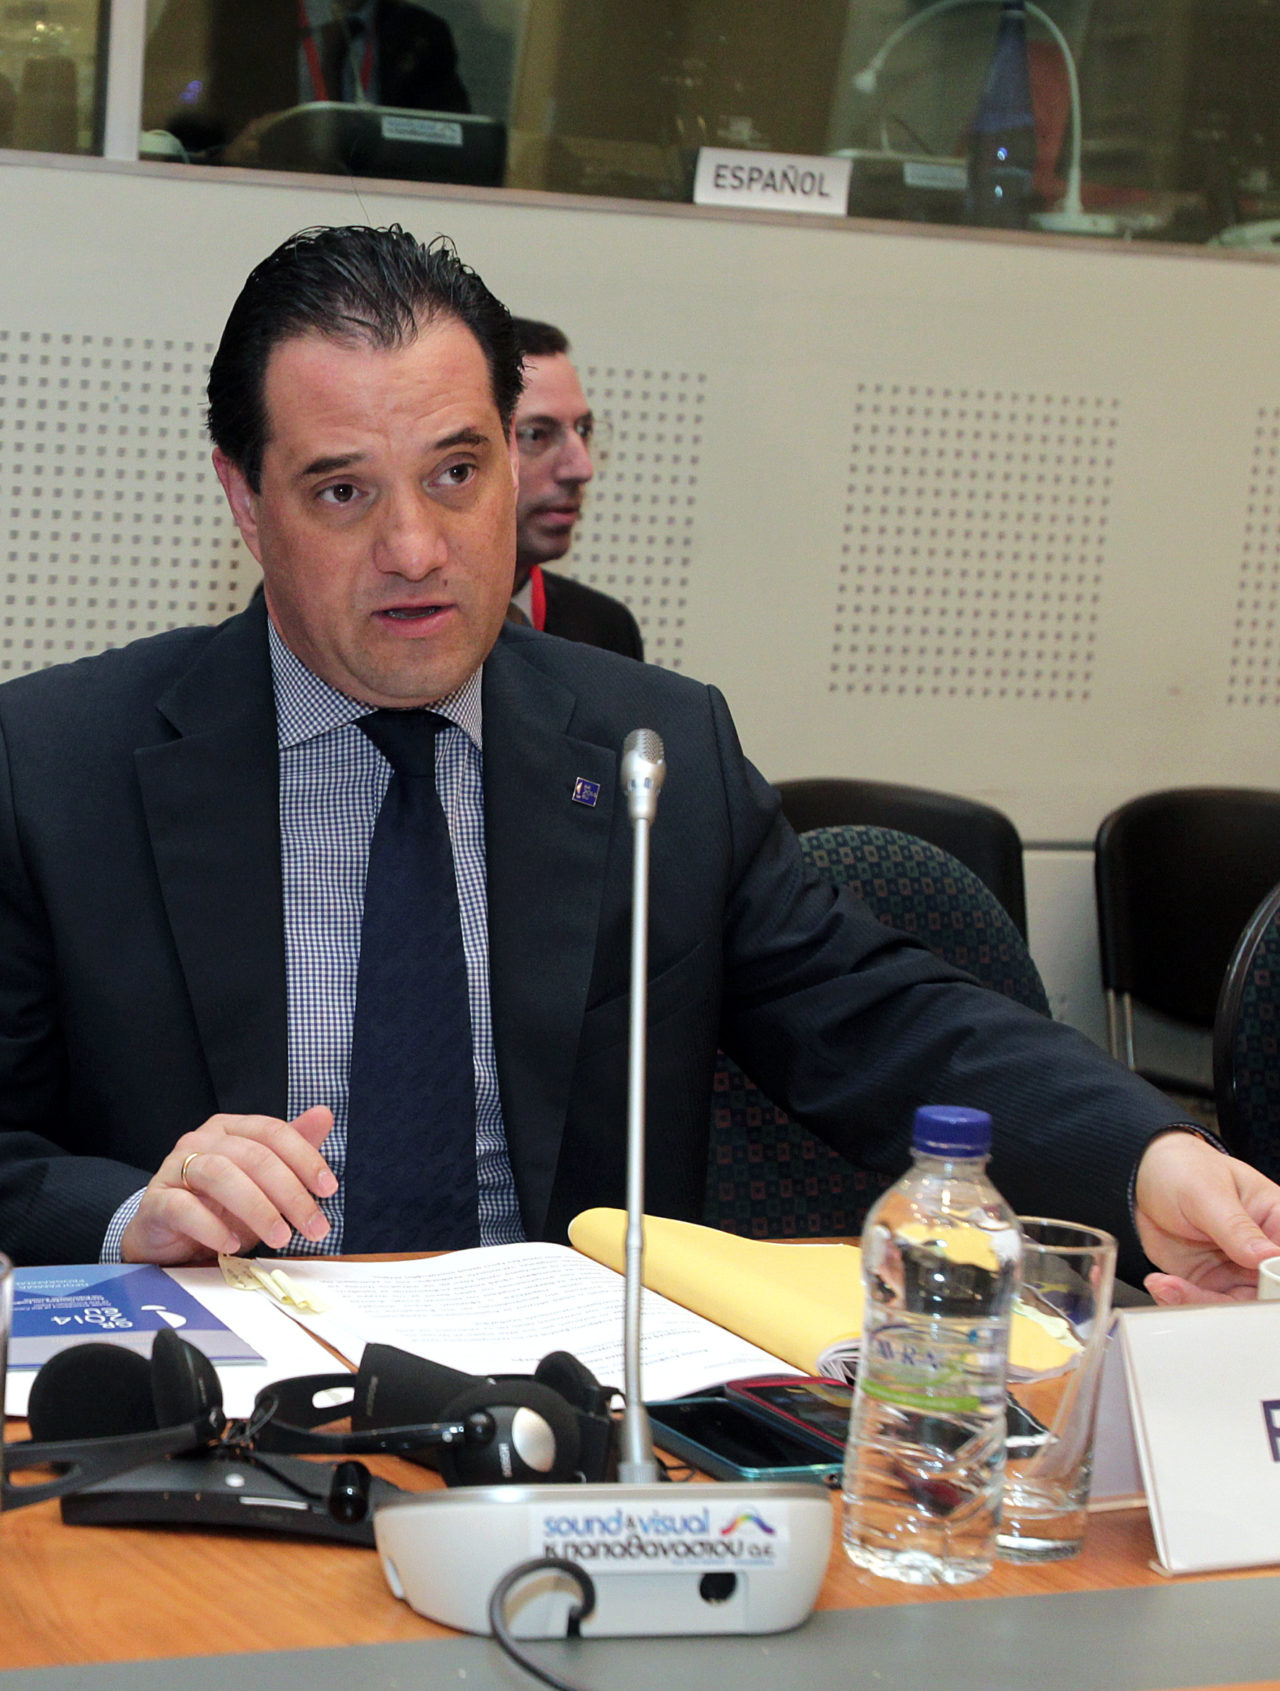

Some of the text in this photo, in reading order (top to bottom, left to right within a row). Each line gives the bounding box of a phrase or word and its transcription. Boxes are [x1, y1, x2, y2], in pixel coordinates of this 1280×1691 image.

[713, 163, 832, 198] ESPAÑOL
[51, 1312, 127, 1326] 2014
[544, 1508, 622, 1536] sound
[638, 1507, 709, 1535] visual
